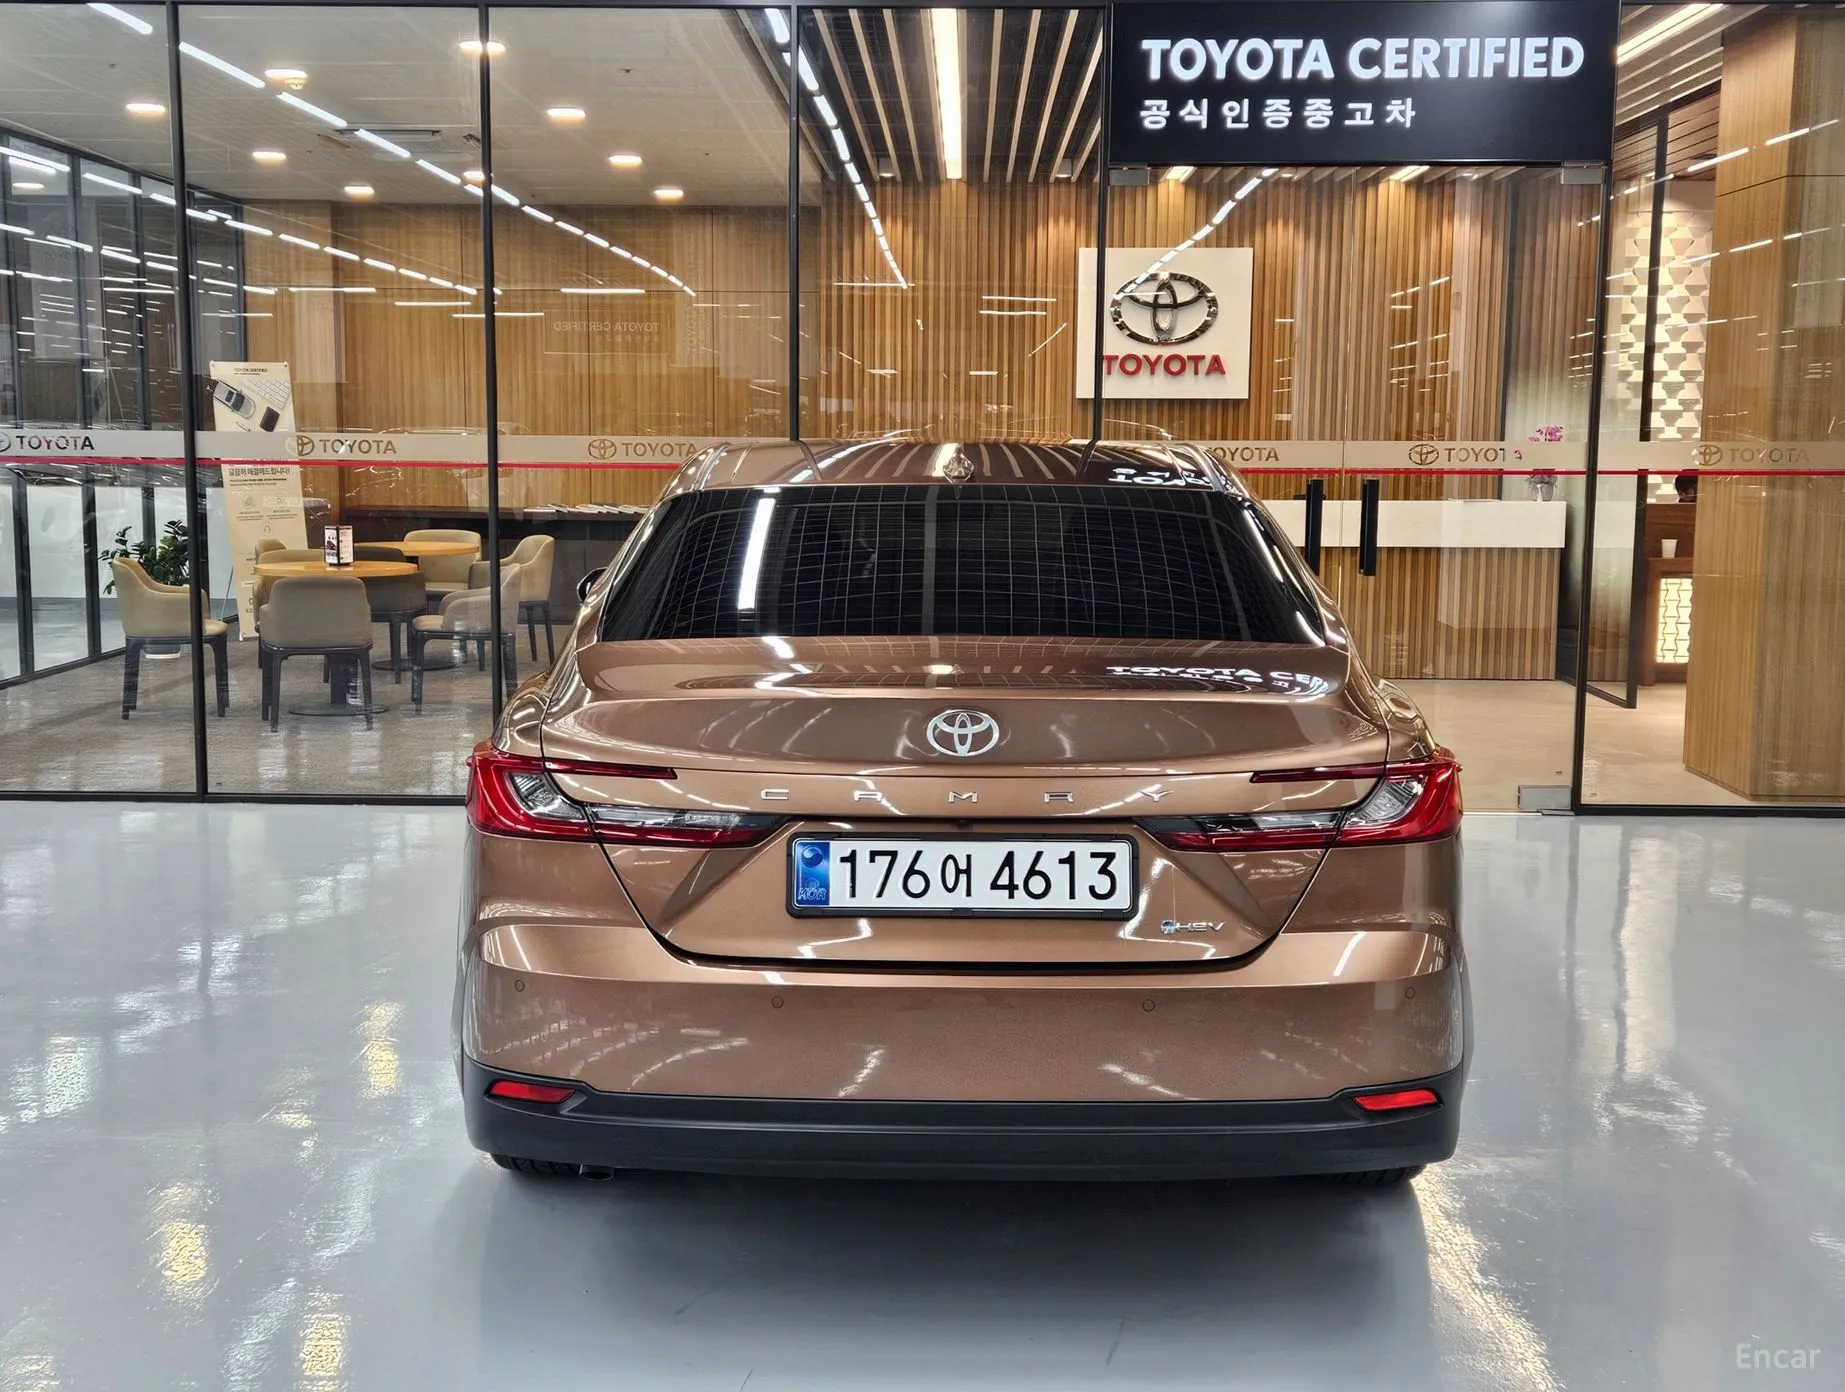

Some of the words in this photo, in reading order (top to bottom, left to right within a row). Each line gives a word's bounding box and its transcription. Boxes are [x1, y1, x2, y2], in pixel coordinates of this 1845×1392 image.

[1141, 37, 1335, 81] TOYOTA
[1348, 36, 1585, 80] CERTIFIED
[1139, 97, 1417, 130] 공식인증중고차
[1102, 353, 1226, 377] TOYOTA
[15, 435, 95, 451] TOYOTA
[319, 439, 397, 454] TOYOTA
[621, 442, 698, 457] TOYOTA
[1208, 446, 1280, 461] OYOTA
[1729, 447, 1811, 463] TOYOTA
[760, 788, 1174, 803] CAMRY
[839, 849, 972, 899] 176어
[989, 850, 1118, 900] 4613
[797, 887, 827, 901] KOR
[1176, 921, 1227, 933] HEV
